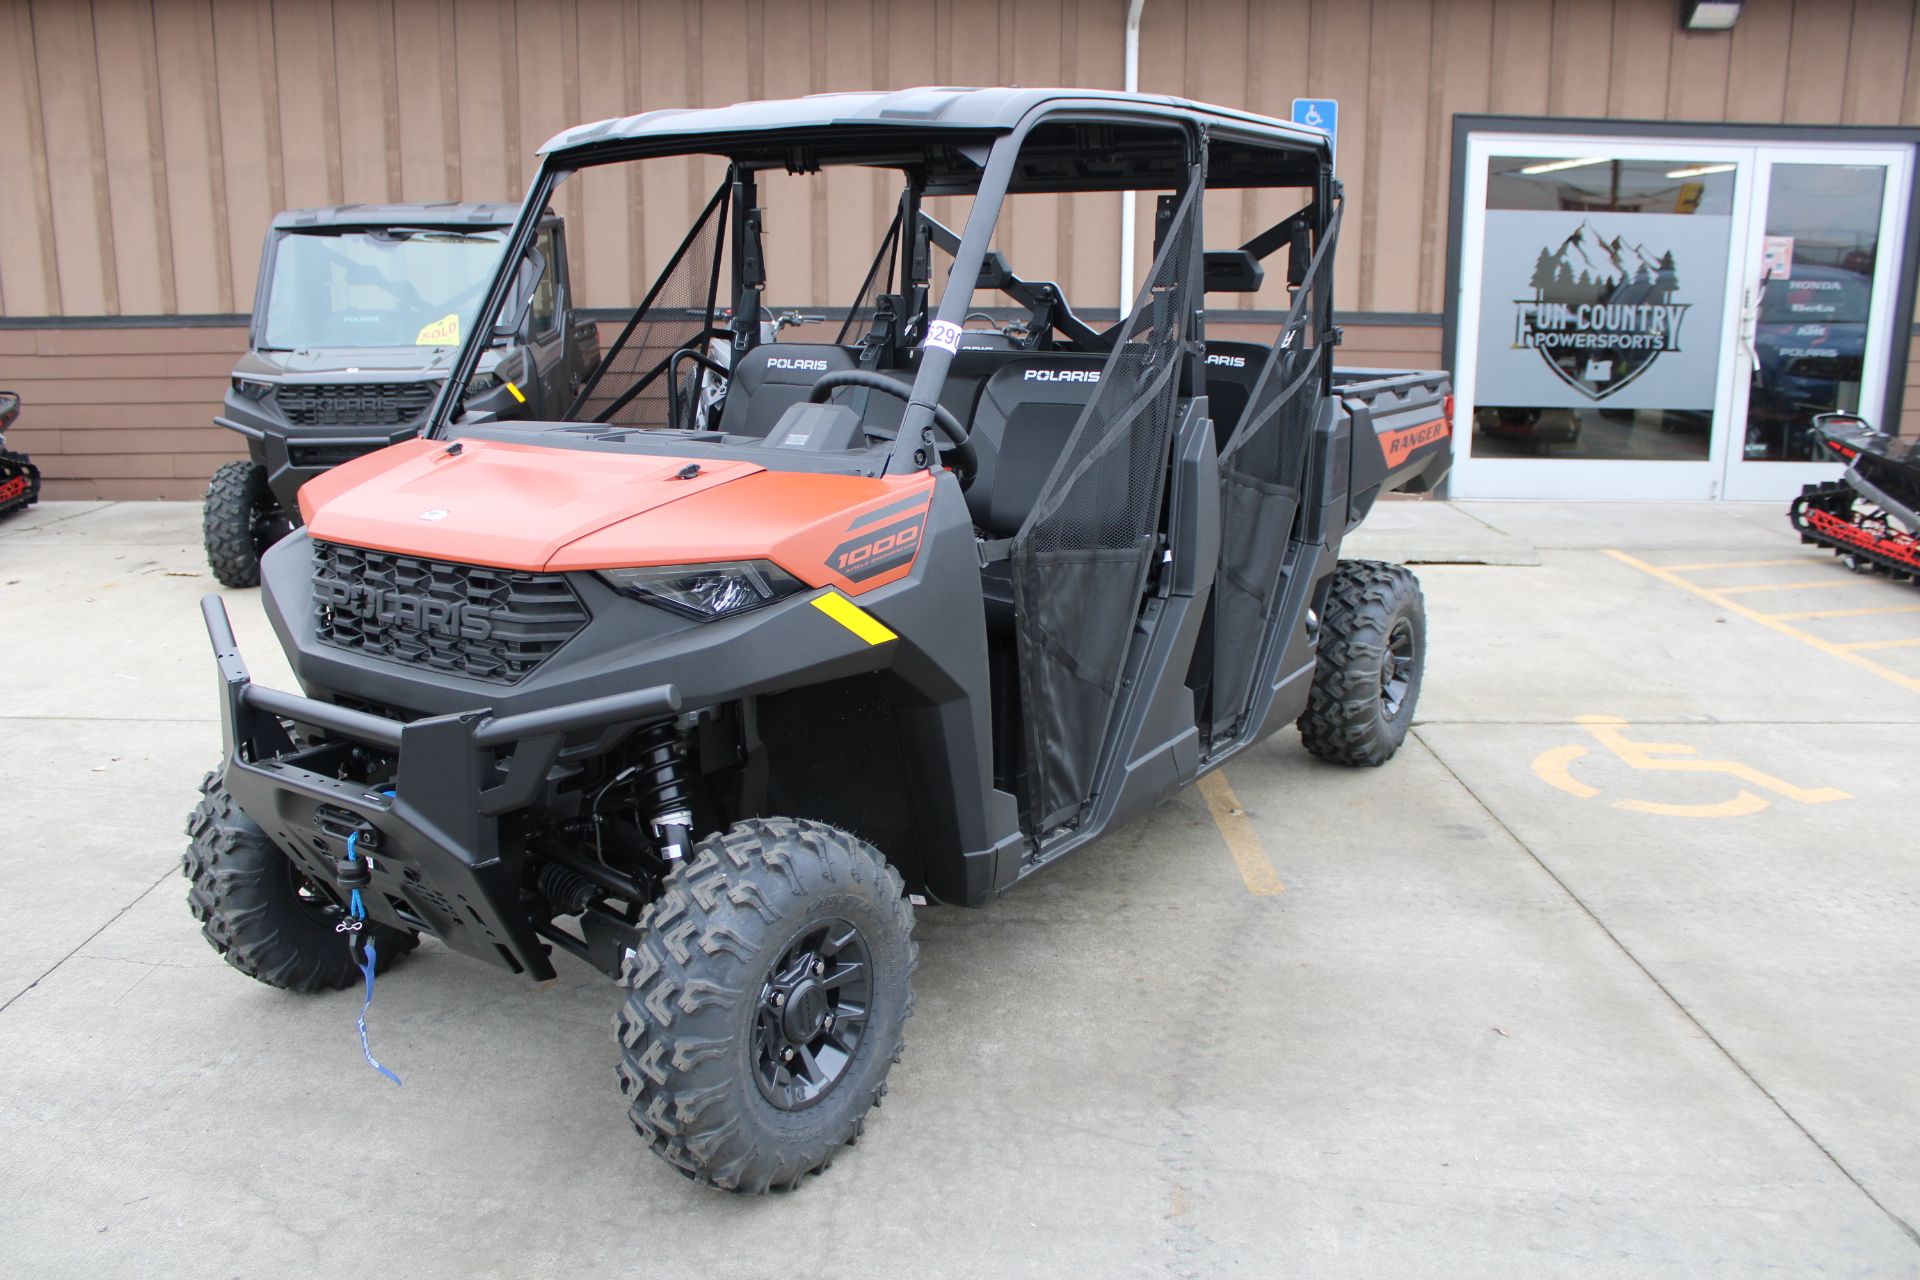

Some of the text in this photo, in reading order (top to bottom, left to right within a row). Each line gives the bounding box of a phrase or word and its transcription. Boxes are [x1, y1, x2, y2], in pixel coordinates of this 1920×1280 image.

[1789, 281, 1842, 290] HONDA
[1511, 301, 1693, 351] FUN COUNTRY
[1535, 333, 1664, 349] POWERSPORTS
[1779, 348, 1838, 358] POLARIS
[767, 358, 828, 371] POLARIS
[1204, 354, 1246, 368] ARIS
[1024, 369, 1101, 382] POLARIS
[302, 398, 399, 411] POLARIS
[1390, 423, 1442, 454] RANGER
[838, 525, 919, 569] 1000
[328, 579, 493, 641] POLARIS
